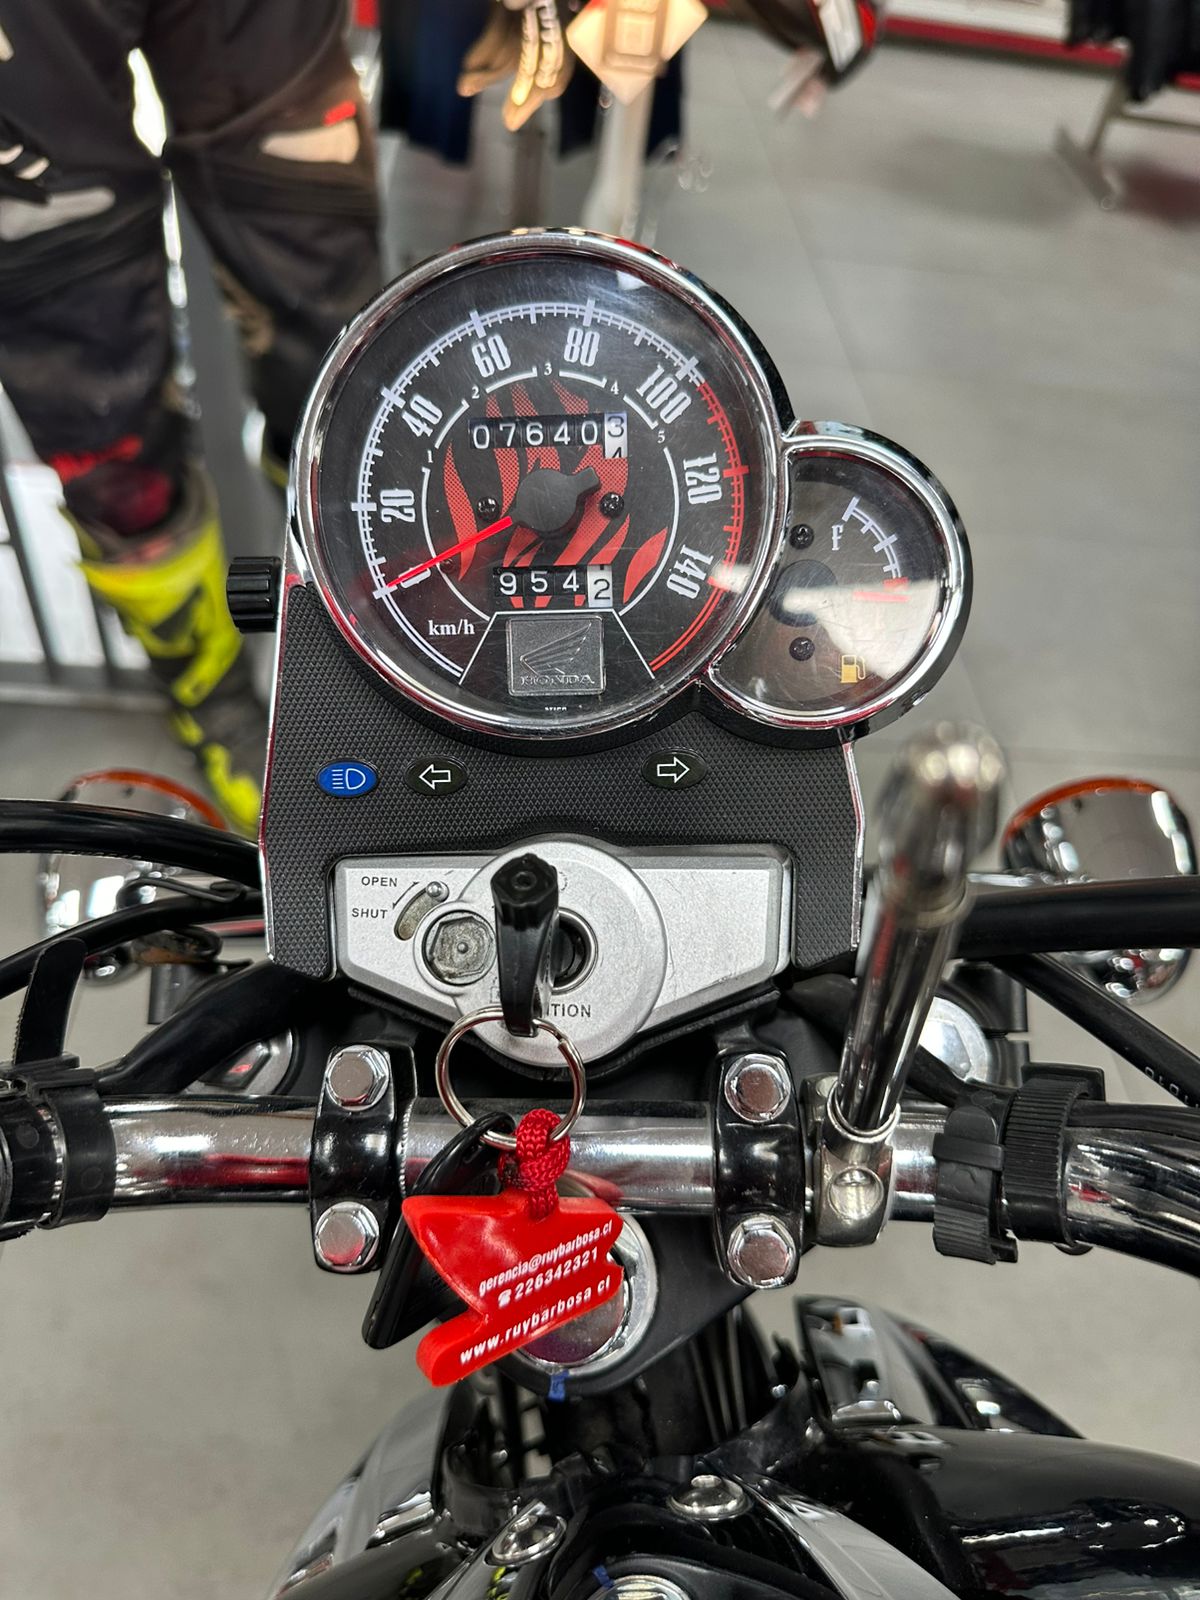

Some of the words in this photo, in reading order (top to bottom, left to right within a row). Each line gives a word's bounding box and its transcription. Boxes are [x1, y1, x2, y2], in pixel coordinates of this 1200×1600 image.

[563, 326, 601, 367] 80
[471, 334, 512, 378] 60
[544, 362, 553, 376] 3
[471, 386, 480, 399] 2
[610, 380, 619, 395] 4
[636, 364, 692, 425] 100
[402, 394, 443, 438] 40
[657, 430, 666, 444] 5
[427, 450, 433, 463] 1
[683, 452, 723, 505] 120
[380, 488, 416, 523] 20
[666, 544, 714, 599] 140
[428, 619, 475, 636] km/h
[520, 674, 596, 686] HONDA
[361, 876, 398, 888] OPEN
[351, 907, 388, 919] SHUT
[546, 1003, 591, 1018] ITION
[479, 1219, 613, 1297] gerencia@ruybarbosa.cl
[514, 1246, 598, 1301] 226342321
